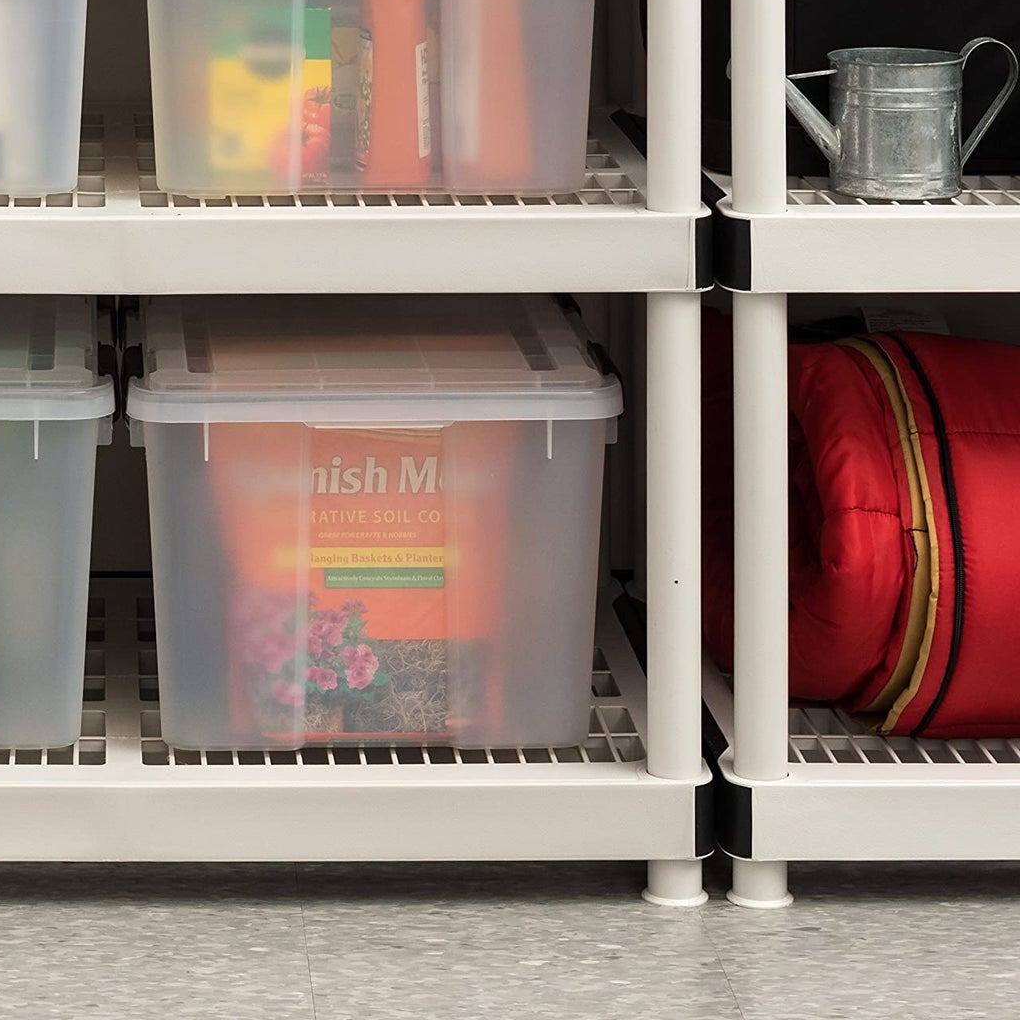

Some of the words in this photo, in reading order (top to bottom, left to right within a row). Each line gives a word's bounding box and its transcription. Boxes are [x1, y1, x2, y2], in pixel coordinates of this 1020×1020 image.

[398, 456, 443, 494] M
[373, 510, 411, 524] SOIL
[418, 510, 441, 524] CO
[351, 553, 393, 563] Baskets
[394, 553, 403, 563] &
